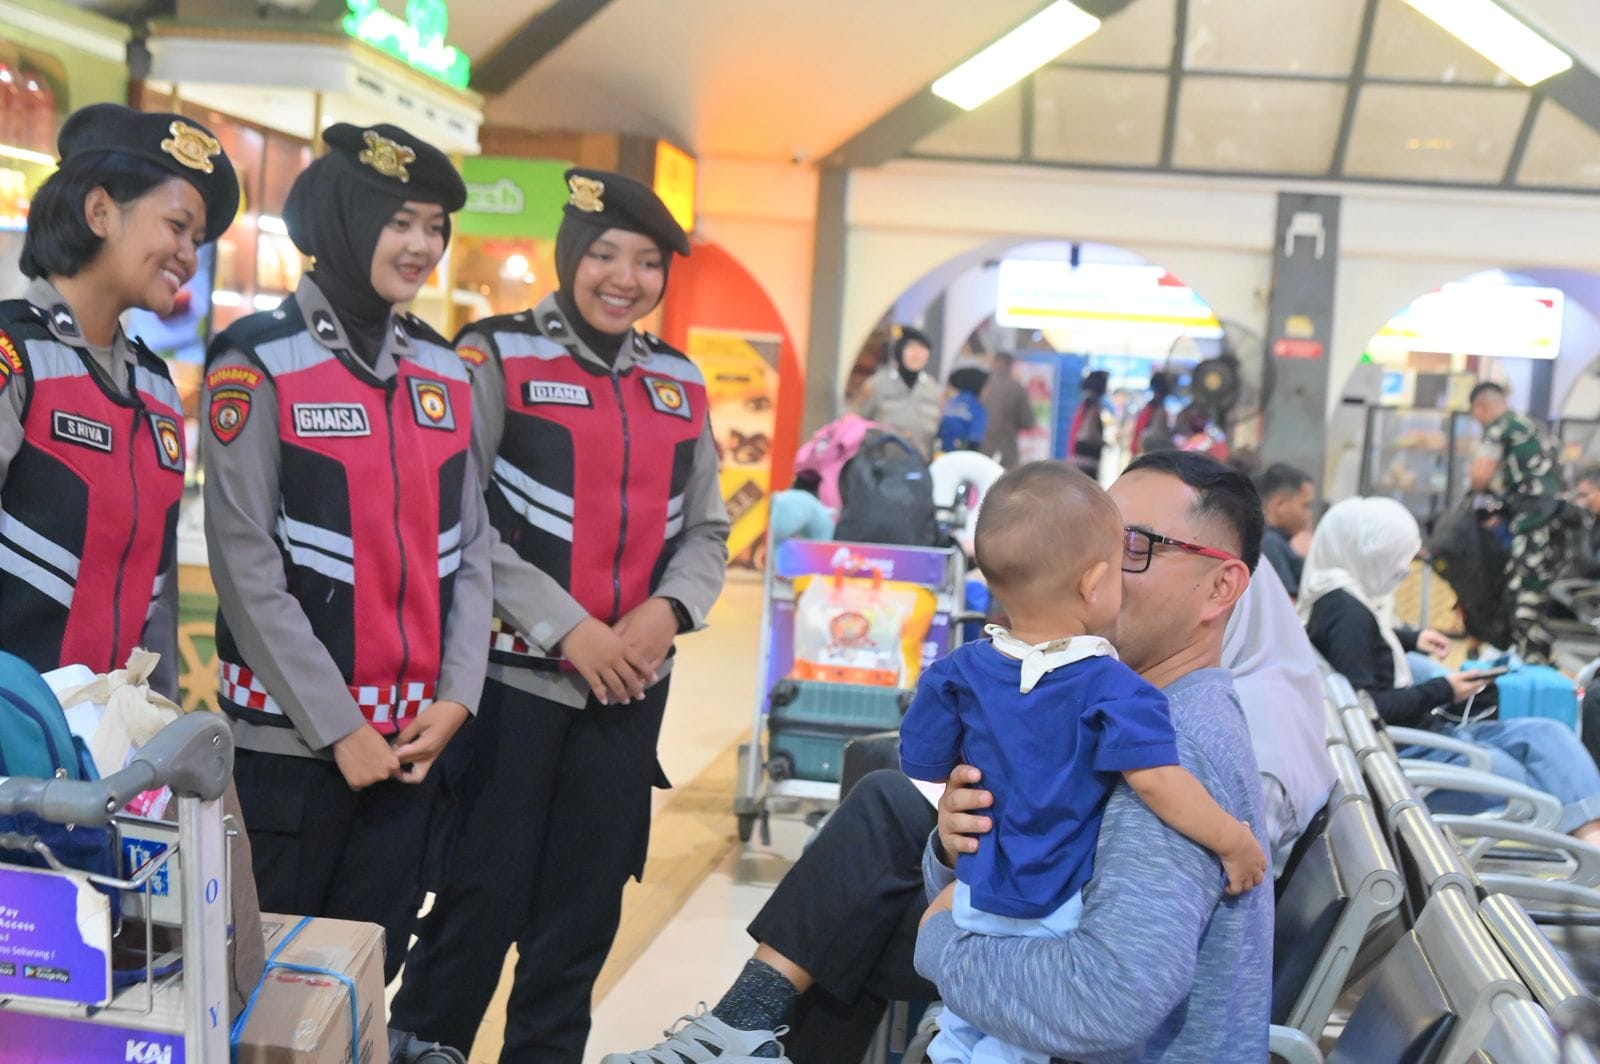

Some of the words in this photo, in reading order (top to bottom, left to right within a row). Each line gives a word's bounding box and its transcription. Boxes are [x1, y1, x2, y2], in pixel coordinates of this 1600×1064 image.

[534, 385, 586, 401] DIANA
[299, 408, 365, 431] GHAISA
[125, 1039, 173, 1064] KAI
